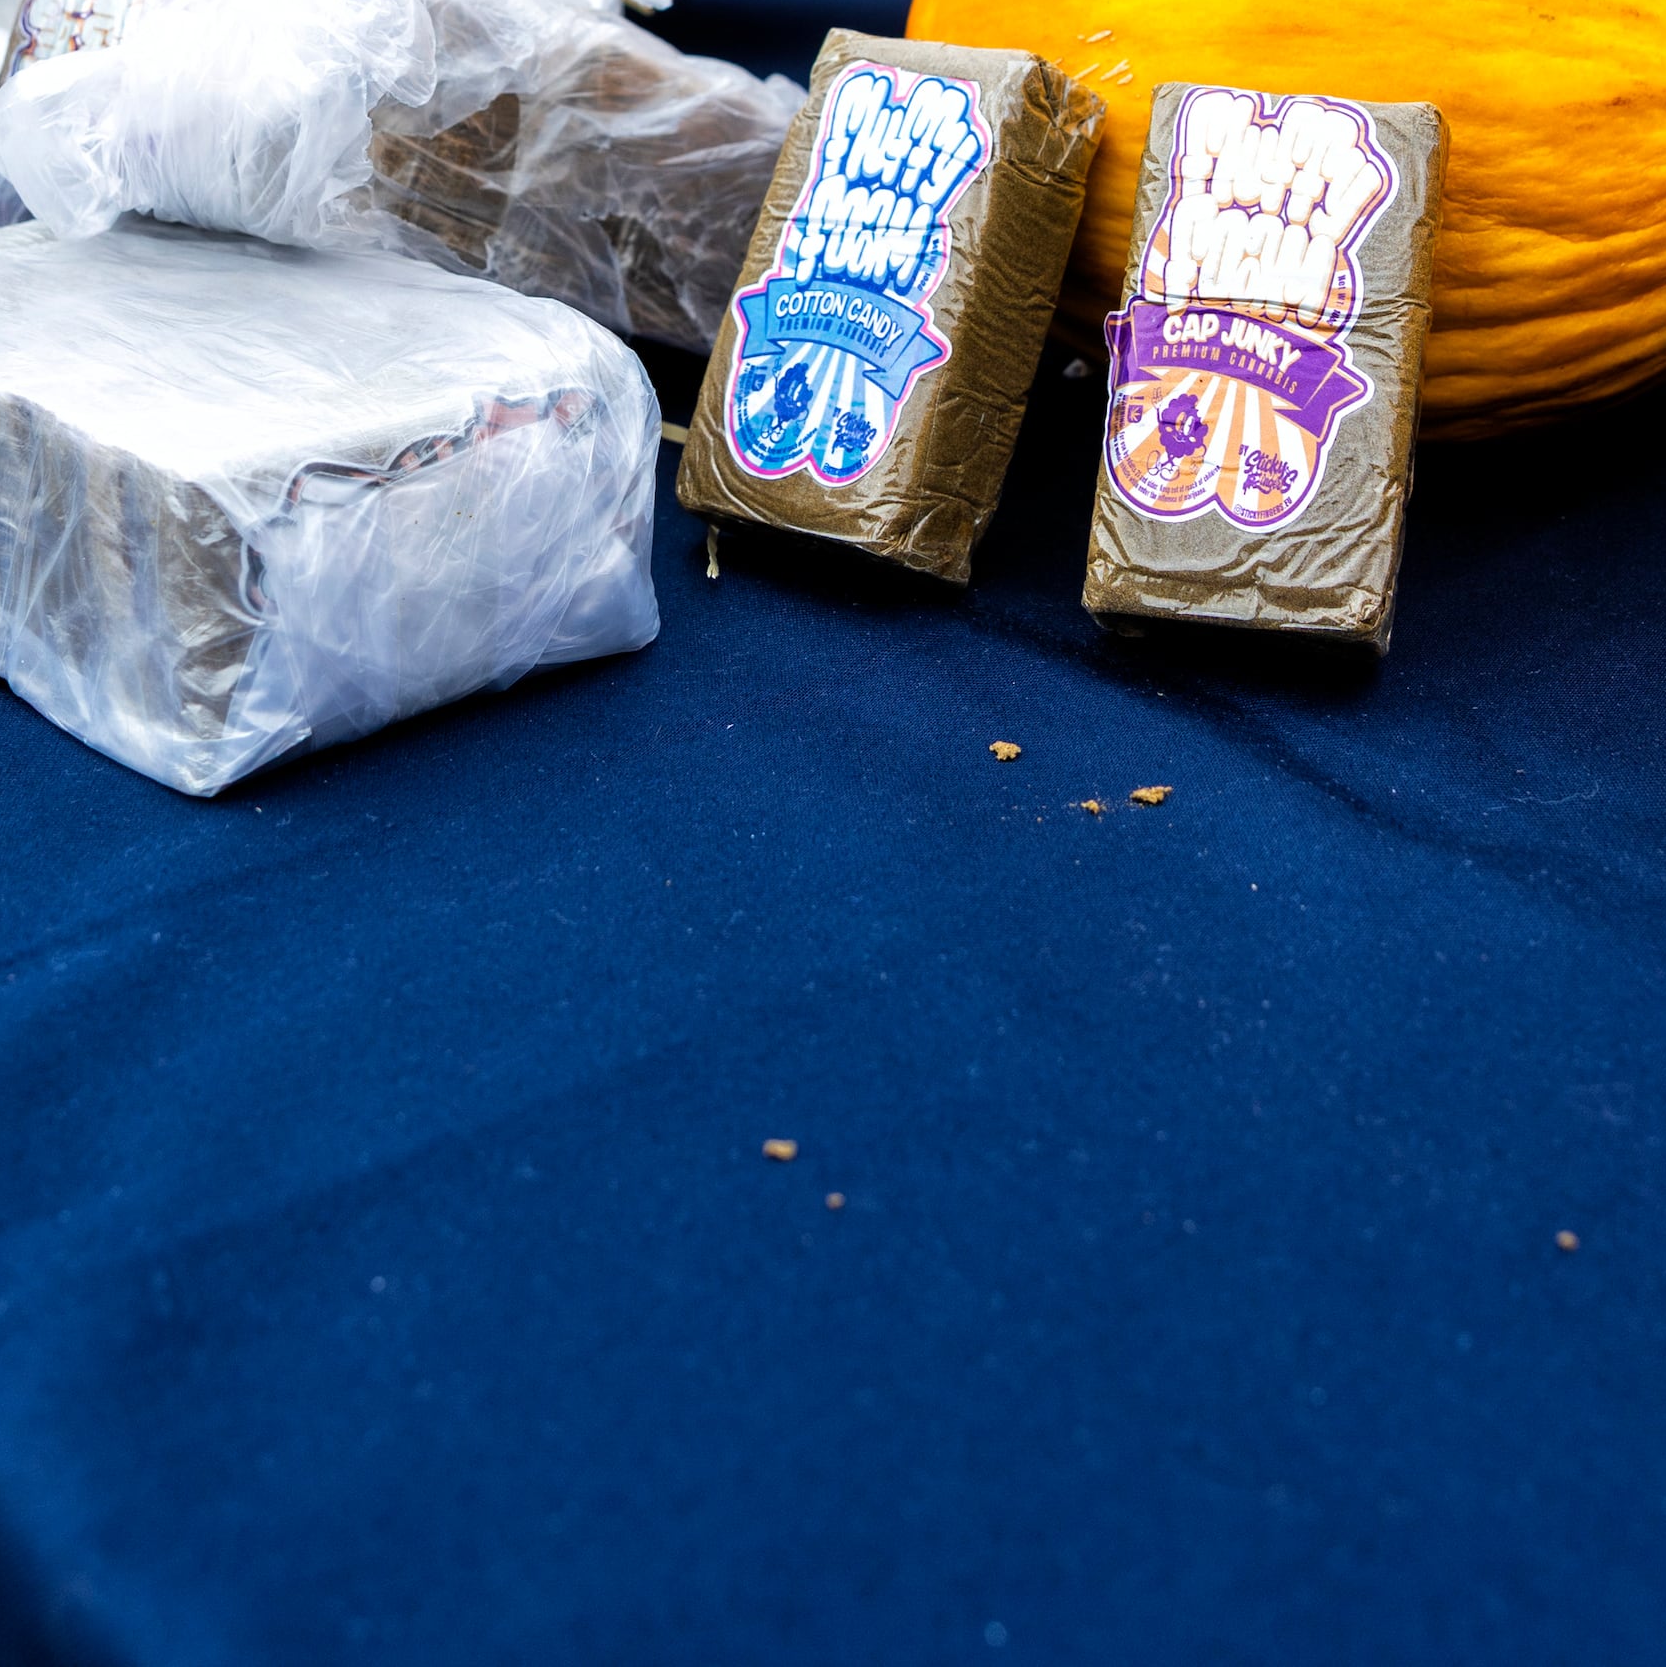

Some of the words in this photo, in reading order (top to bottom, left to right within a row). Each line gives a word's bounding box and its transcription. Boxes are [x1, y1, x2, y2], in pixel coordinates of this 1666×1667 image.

[775, 290, 848, 318] COTTON
[846, 297, 903, 348] CANDY
[1162, 313, 1220, 344] CAP
[1220, 317, 1302, 373] JUNKY
[1152, 345, 1221, 361] PREMIUM
[1229, 352, 1298, 394] CANNABIS
